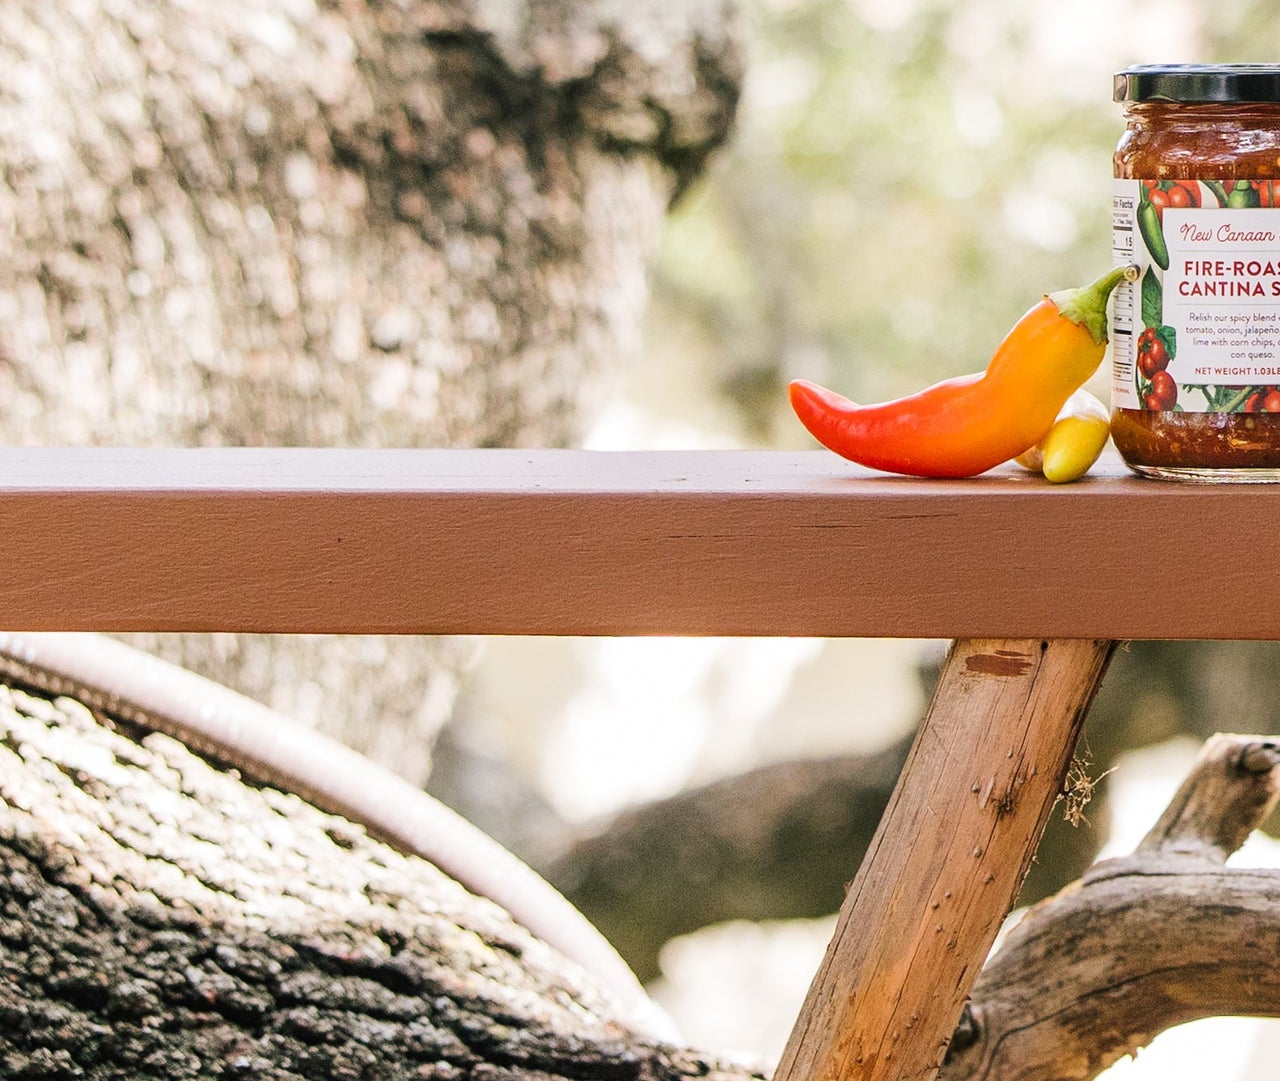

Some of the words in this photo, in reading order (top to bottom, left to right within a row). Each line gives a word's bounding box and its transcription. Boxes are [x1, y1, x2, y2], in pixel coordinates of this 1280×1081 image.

[1180, 223, 1212, 241] New
[1217, 224, 1275, 242] Canaan
[1179, 281, 1265, 296] CANTINA
[1190, 313, 1212, 321] Relish
[1253, 313, 1276, 321] blend
[1193, 337, 1209, 346] lime
[1211, 338, 1228, 346] with
[1195, 367, 1211, 375] NET
[1214, 367, 1251, 375] WEIGHT
